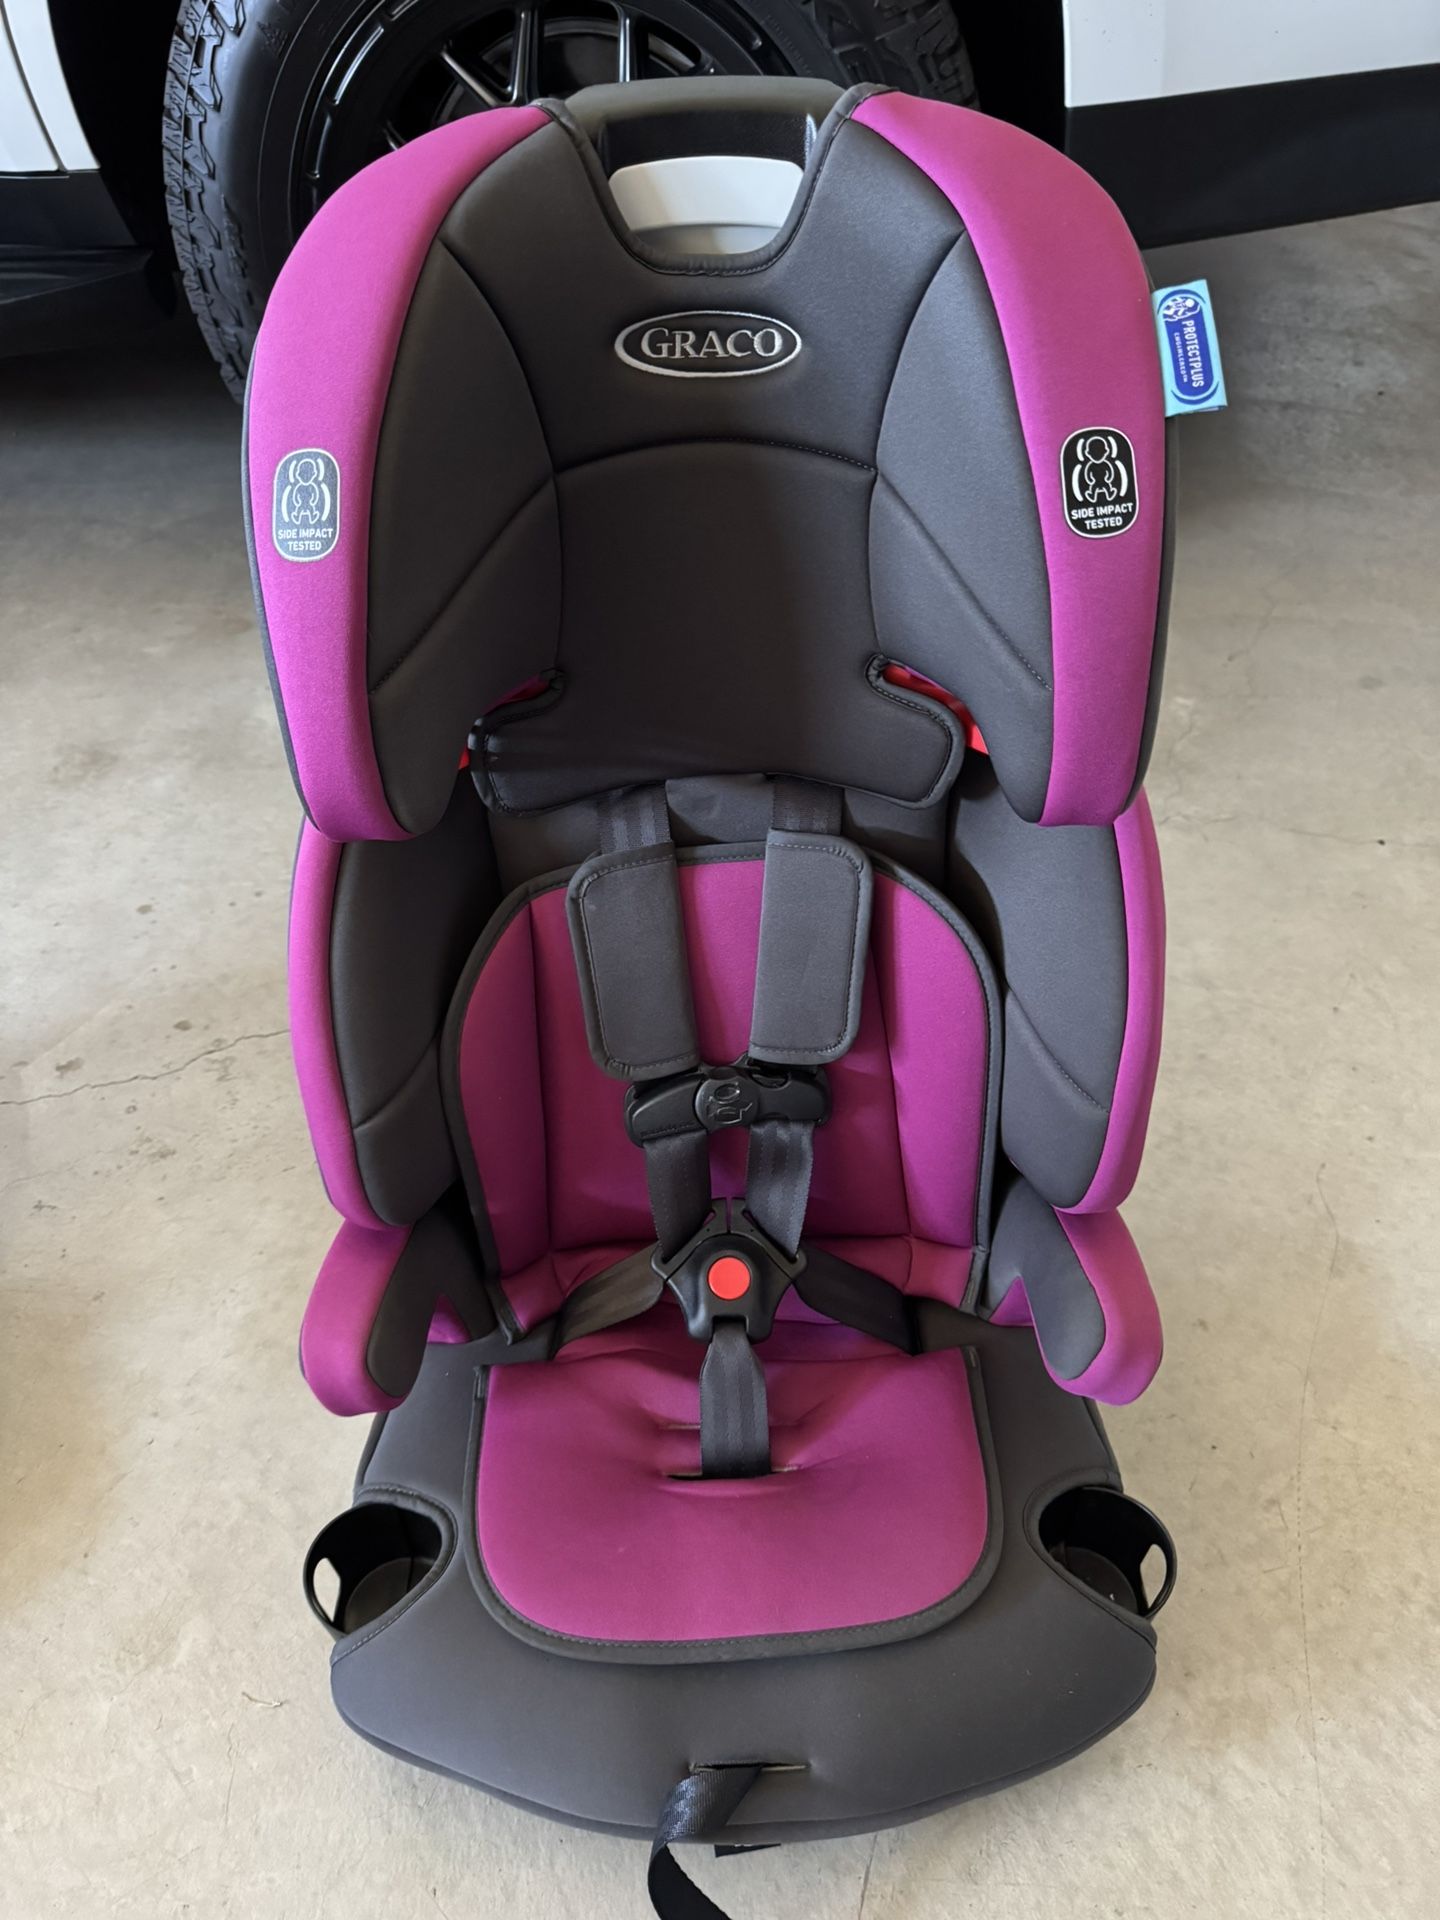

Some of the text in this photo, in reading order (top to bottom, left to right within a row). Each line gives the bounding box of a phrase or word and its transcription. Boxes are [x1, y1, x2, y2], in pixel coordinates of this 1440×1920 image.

[641, 327, 783, 359] GRACO
[1182, 319, 1205, 387] PROTECTPLUS
[1071, 503, 1133, 520] SIDE IMPACT
[1085, 516, 1123, 530] TESTED
[278, 528, 333, 539] SIDE IMPACT
[288, 541, 322, 551] TESTED
